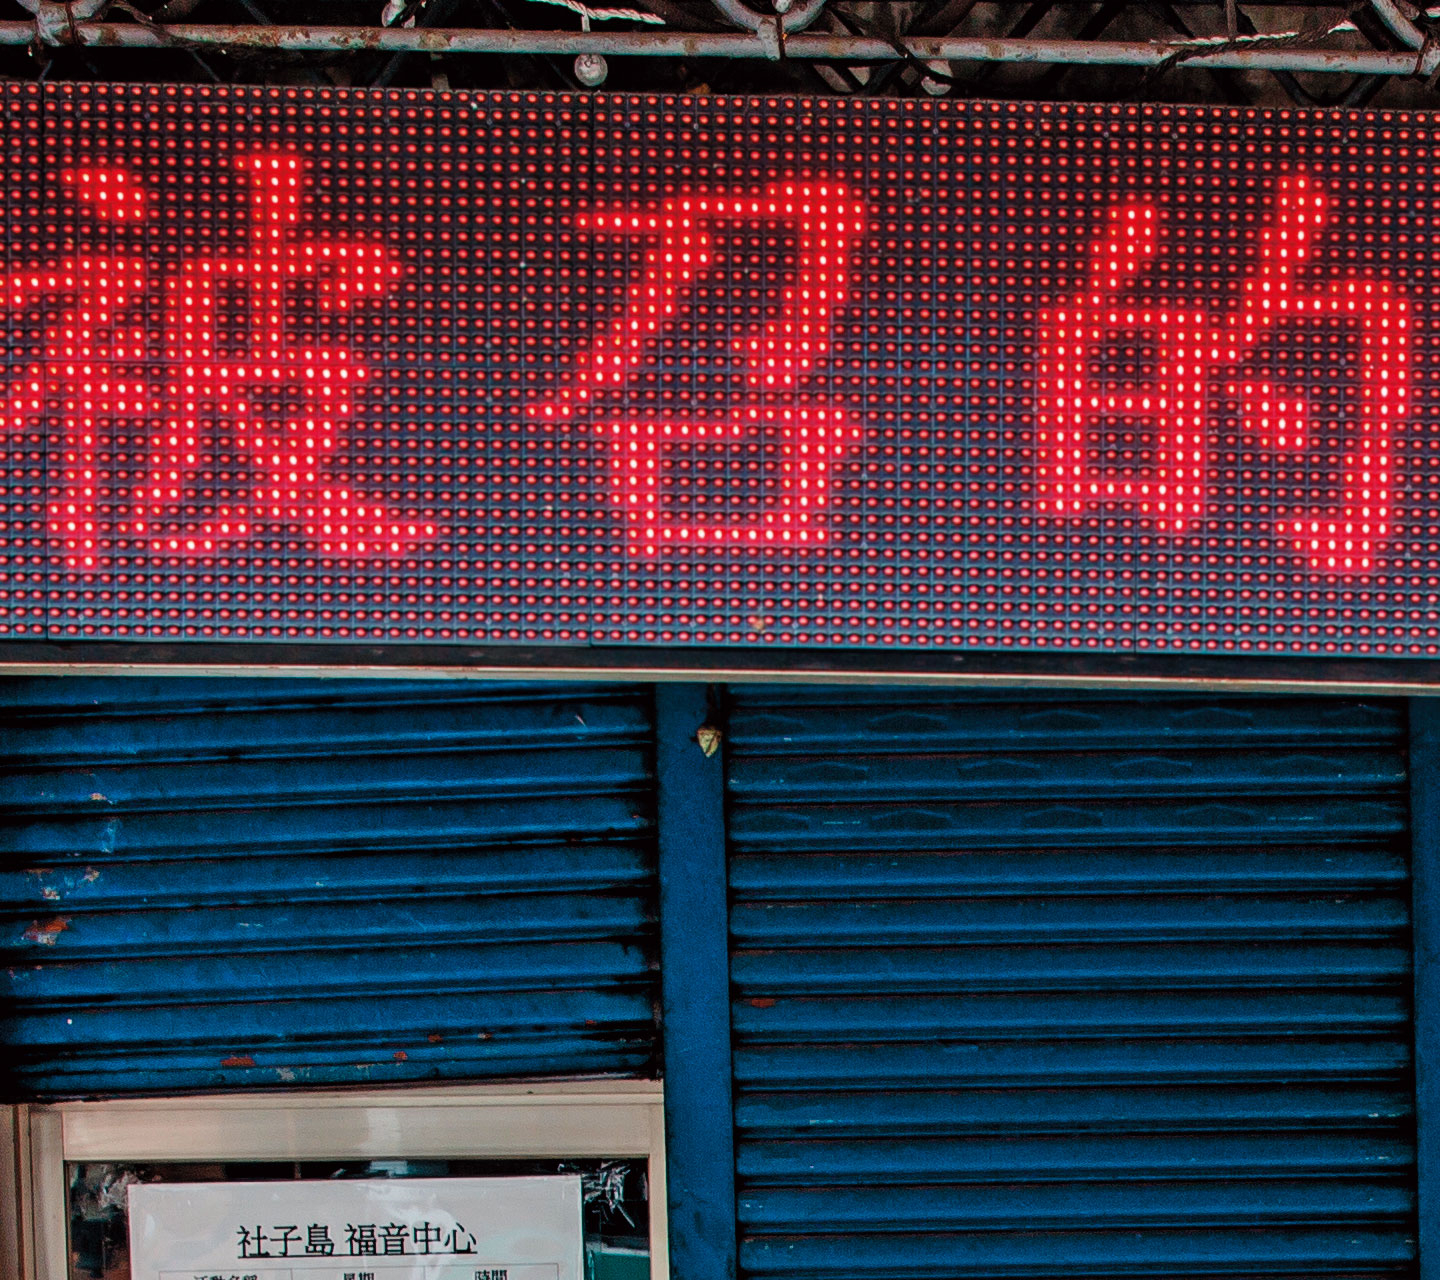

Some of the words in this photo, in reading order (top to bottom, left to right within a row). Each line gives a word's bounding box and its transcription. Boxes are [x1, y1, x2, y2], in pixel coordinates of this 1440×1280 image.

[237, 1224, 334, 1257] 社子島
[344, 1222, 477, 1255] 福音中心
